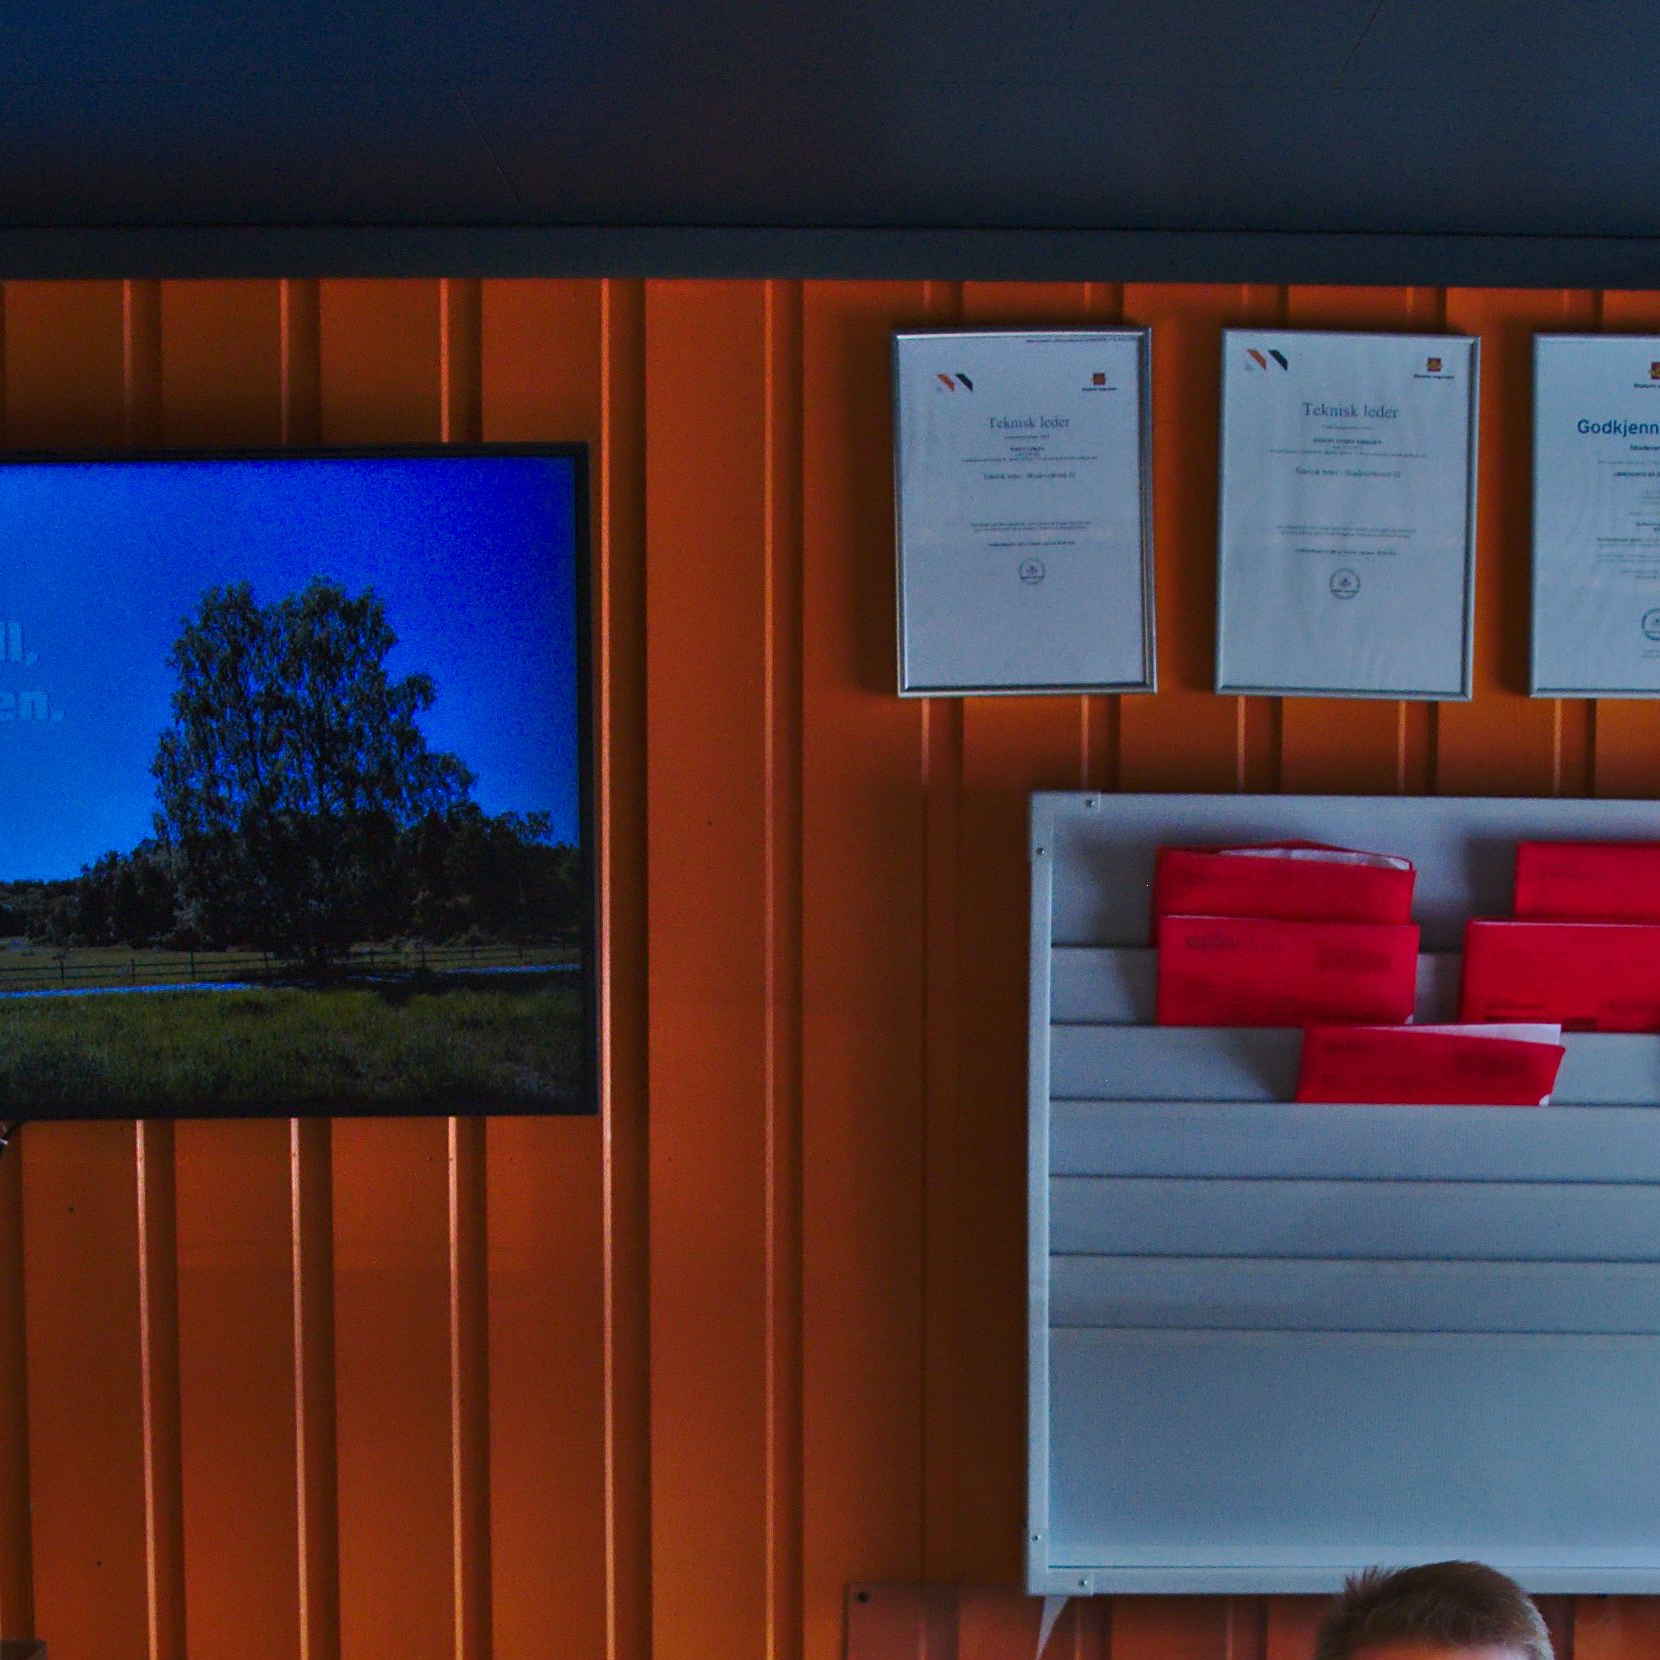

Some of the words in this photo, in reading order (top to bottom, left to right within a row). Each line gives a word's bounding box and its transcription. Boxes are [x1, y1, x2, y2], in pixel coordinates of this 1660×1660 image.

[1303, 402, 1357, 417] Teknisk
[1364, 403, 1399, 418] leder
[989, 416, 1035, 429] Teknisk
[1040, 416, 1070, 429] leder
